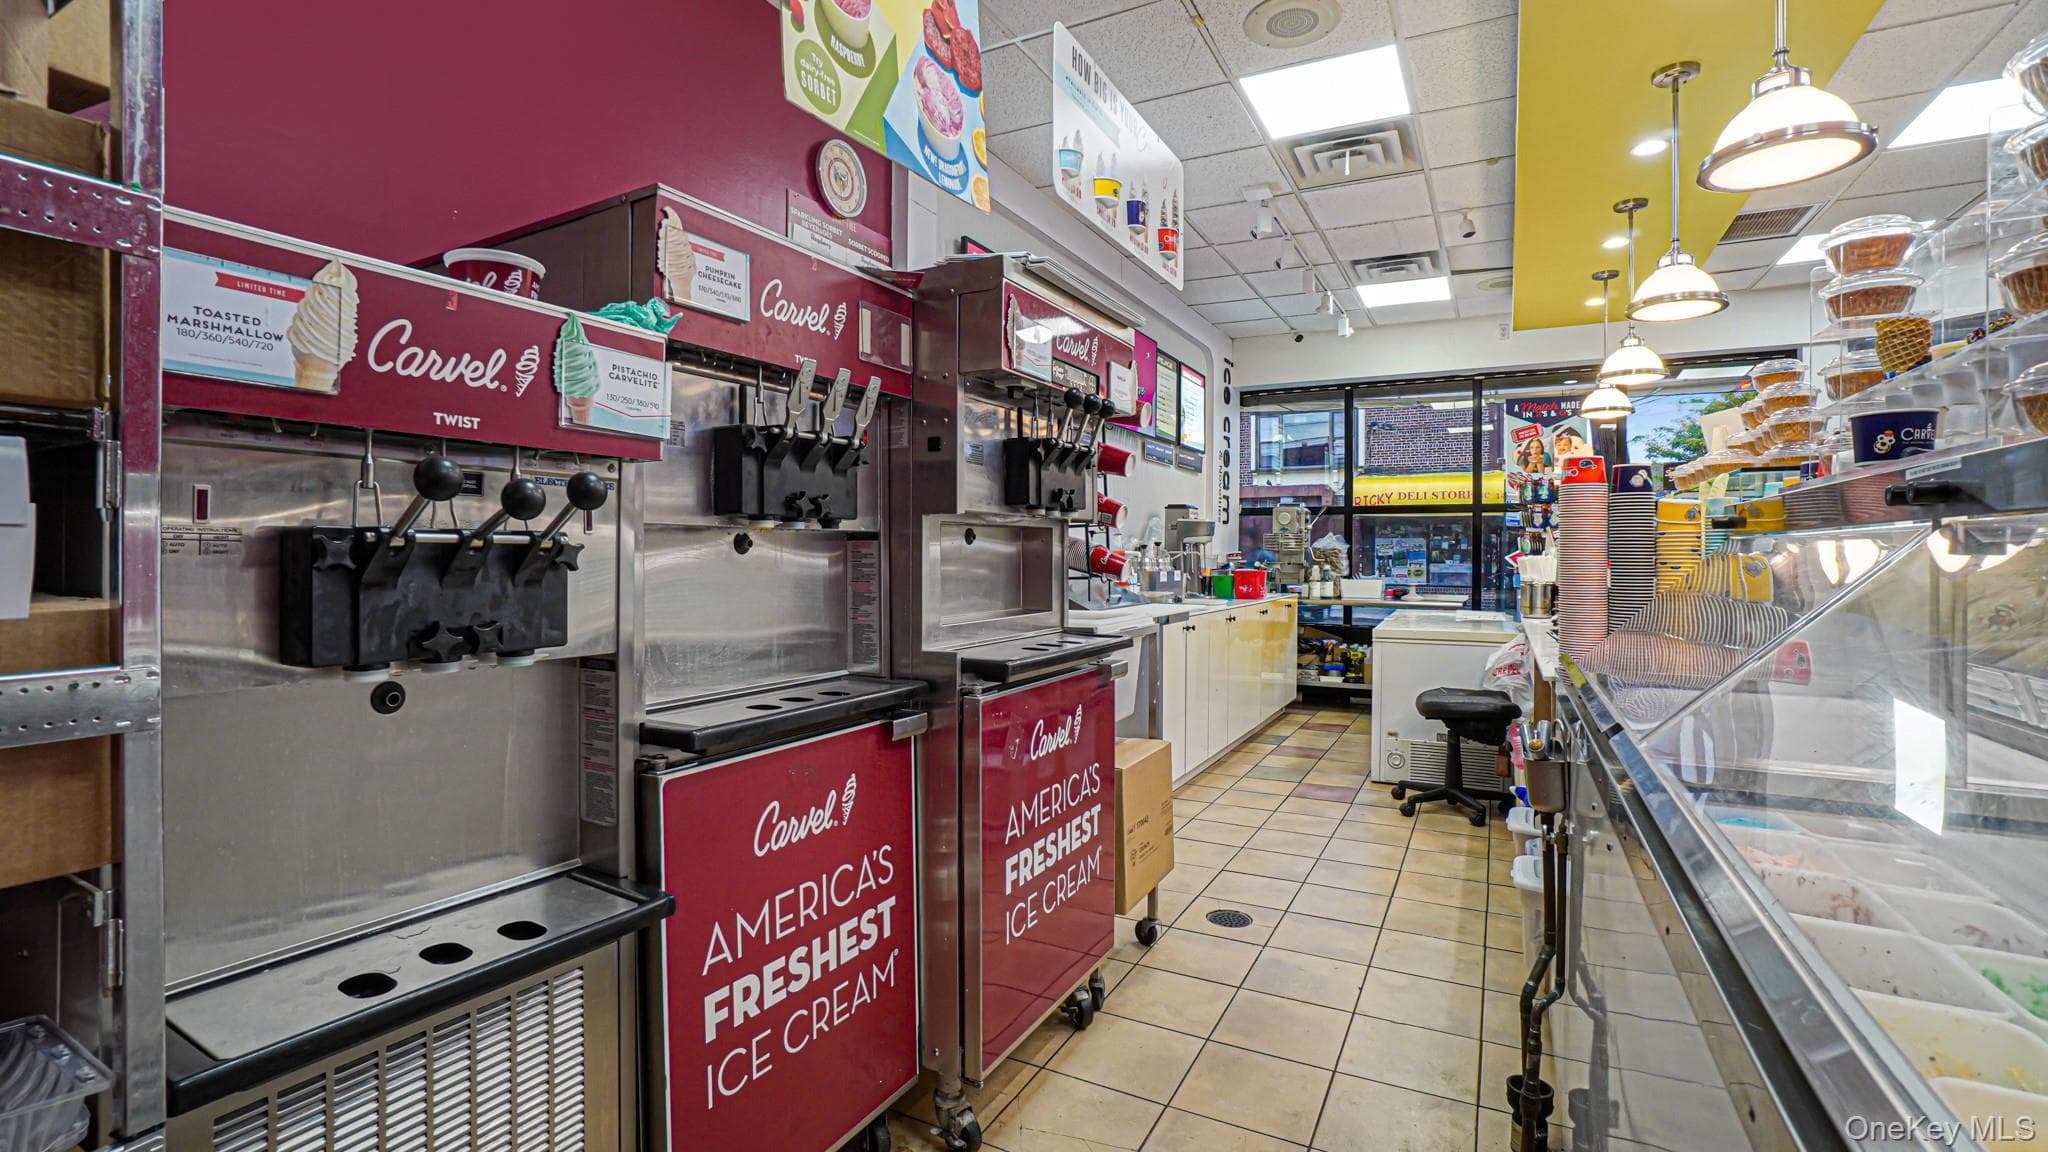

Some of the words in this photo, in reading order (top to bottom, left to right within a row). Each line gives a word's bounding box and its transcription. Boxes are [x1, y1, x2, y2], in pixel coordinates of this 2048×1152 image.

[811, 52, 824, 68] Try
[830, 34, 865, 67] RASPBERRY
[800, 70, 836, 106] SORBET
[1071, 45, 1092, 85] HOW
[1094, 71, 1107, 104] BIG
[790, 207, 821, 226] SPARKLING
[822, 220, 842, 236] SORBET
[848, 238, 867, 252] SORBET
[697, 270, 742, 289] CHEESECAKE
[705, 265, 735, 280] PUMPKIN
[236, 281, 267, 293] LIMITED
[269, 287, 286, 297] TIME
[167, 314, 284, 342] MARSHMALLOW
[193, 305, 262, 326] TOASTED
[176, 327, 274, 352] 180/360/540/720
[612, 363, 658, 380] PISTACHIO
[1223, 357, 1234, 405] ice
[433, 412, 481, 429] TWIST
[1513, 404, 1519, 412] A
[1560, 401, 1581, 410] MADE
[1522, 411, 1533, 419] IN
[1222, 416, 1231, 525] cream
[1354, 491, 1394, 506] RICKY
[1397, 491, 1427, 501] DELI
[1005, 762, 1100, 844] AMERICA'S
[1005, 803, 1101, 895] FRESHEST
[702, 844, 894, 977] AMERICA'S
[1005, 891, 1038, 945] ICE
[1042, 853, 1101, 914] CREAM
[703, 895, 896, 1044] FRESHEST
[706, 1029, 773, 1110] ICE
[783, 955, 896, 1054] CREAM
